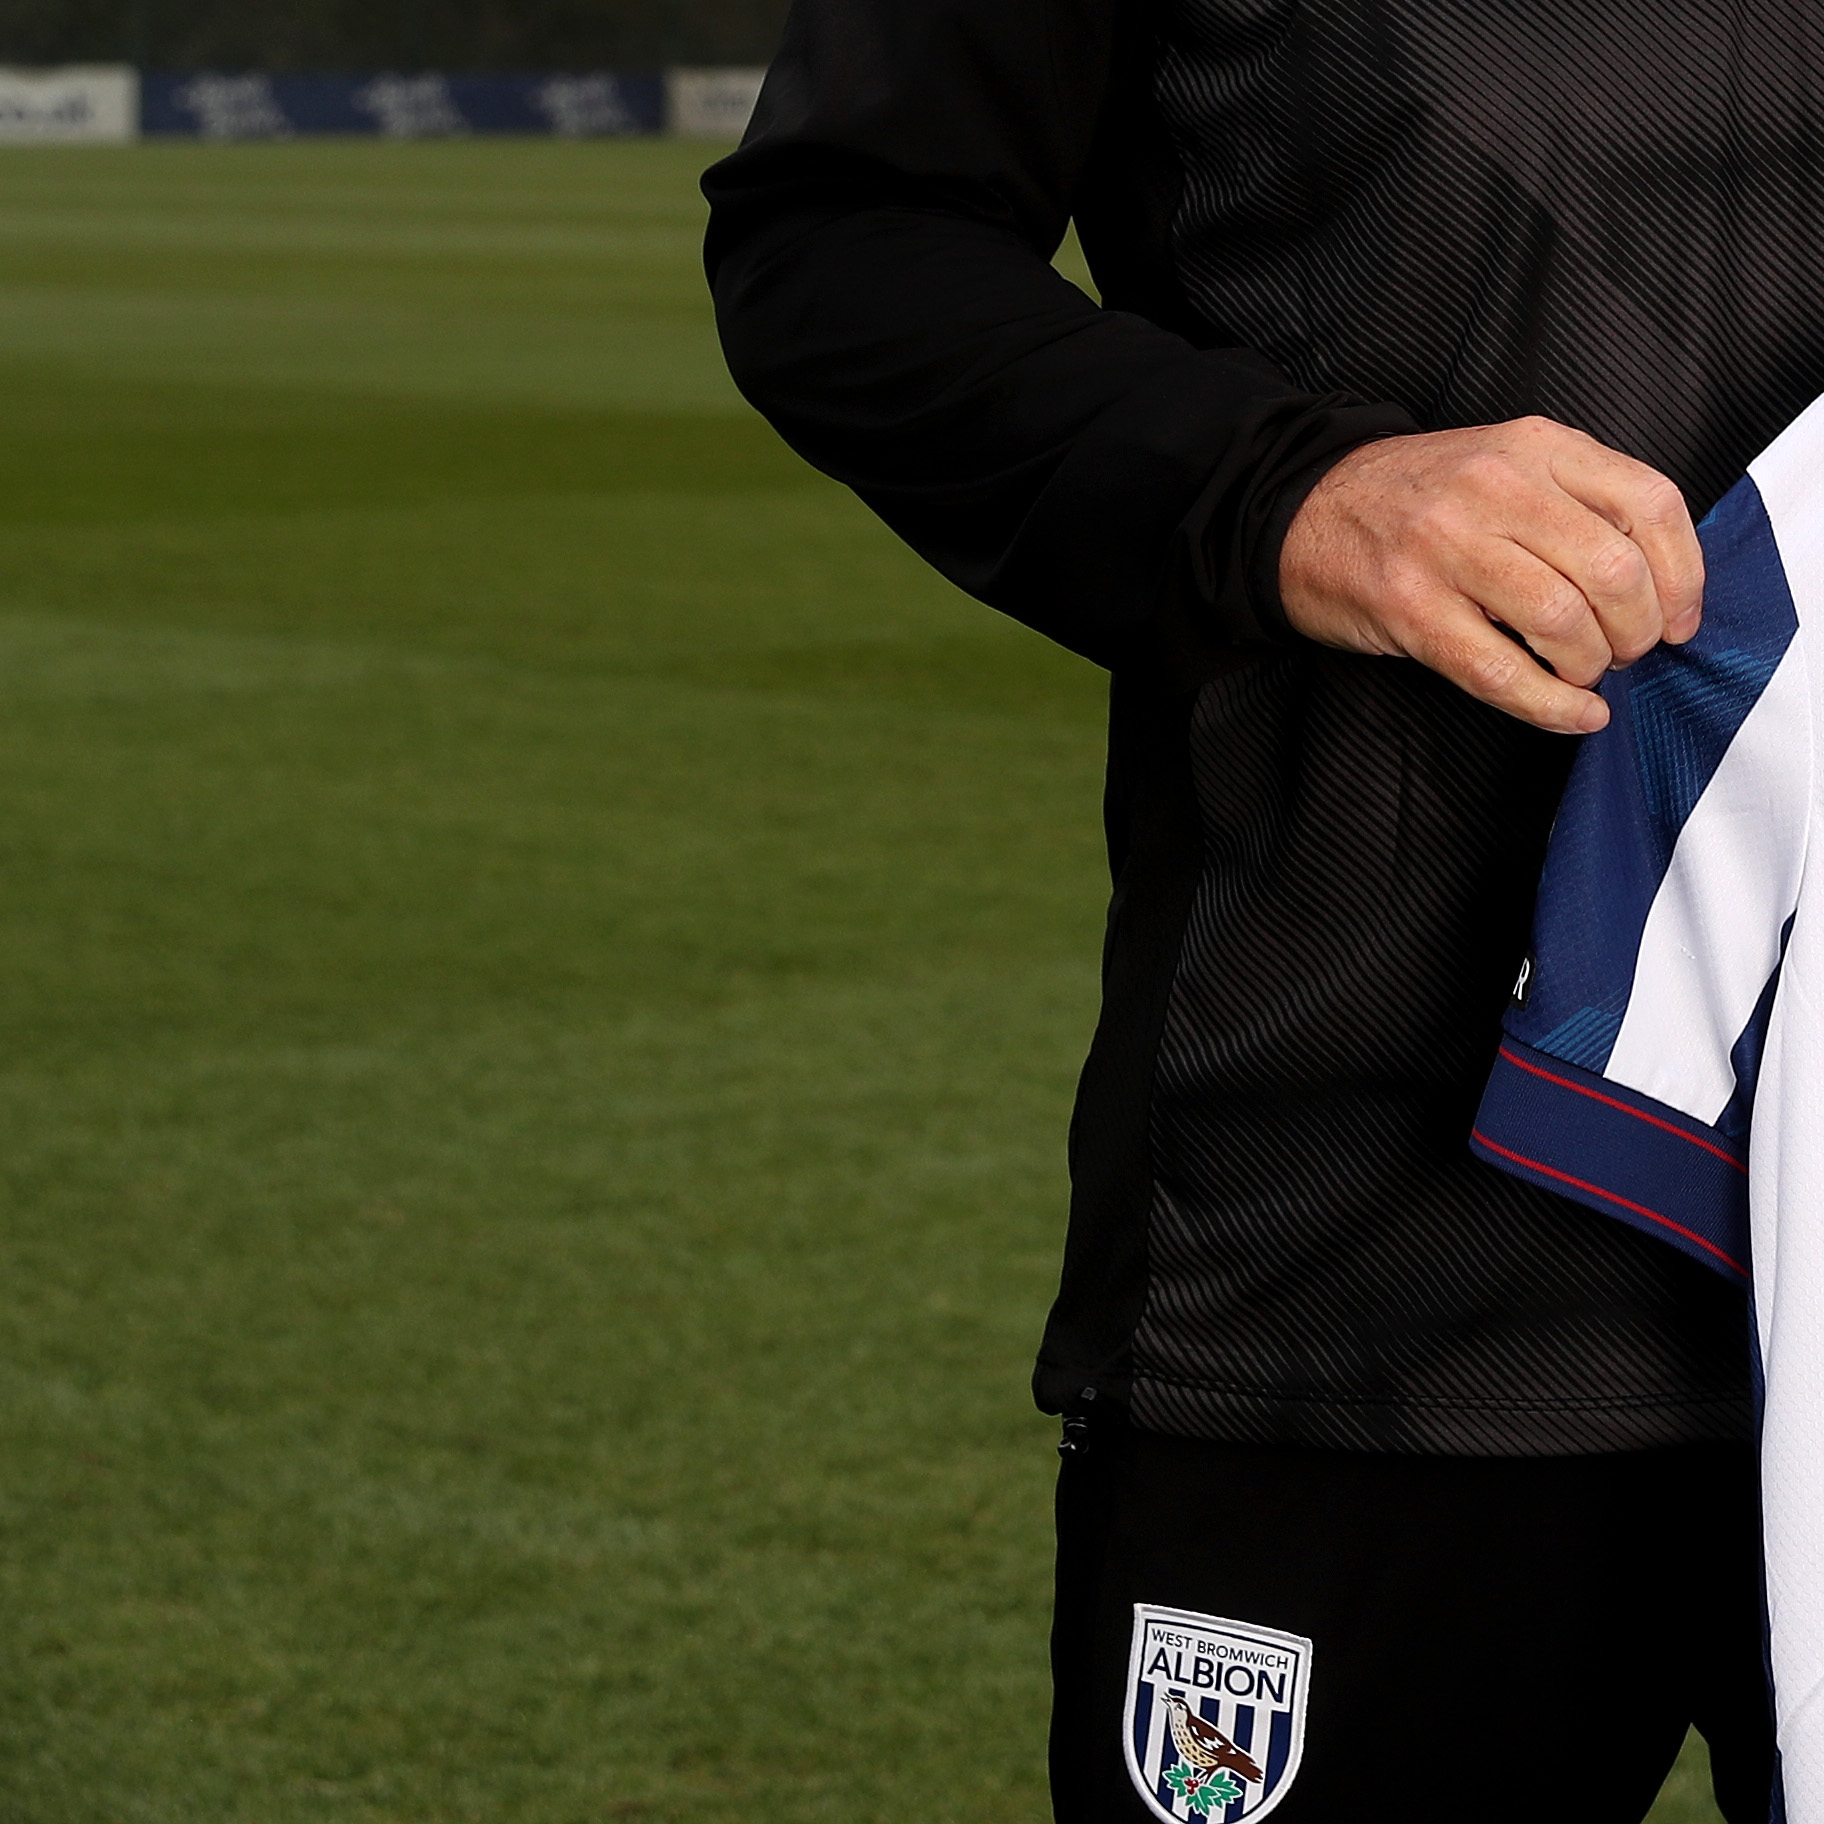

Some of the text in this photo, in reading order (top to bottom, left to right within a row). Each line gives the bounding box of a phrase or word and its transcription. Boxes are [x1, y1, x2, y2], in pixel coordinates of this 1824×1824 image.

[1152, 1628, 1289, 1670] WEST BROMWICH
[1147, 1647, 1287, 1704] ALBION
